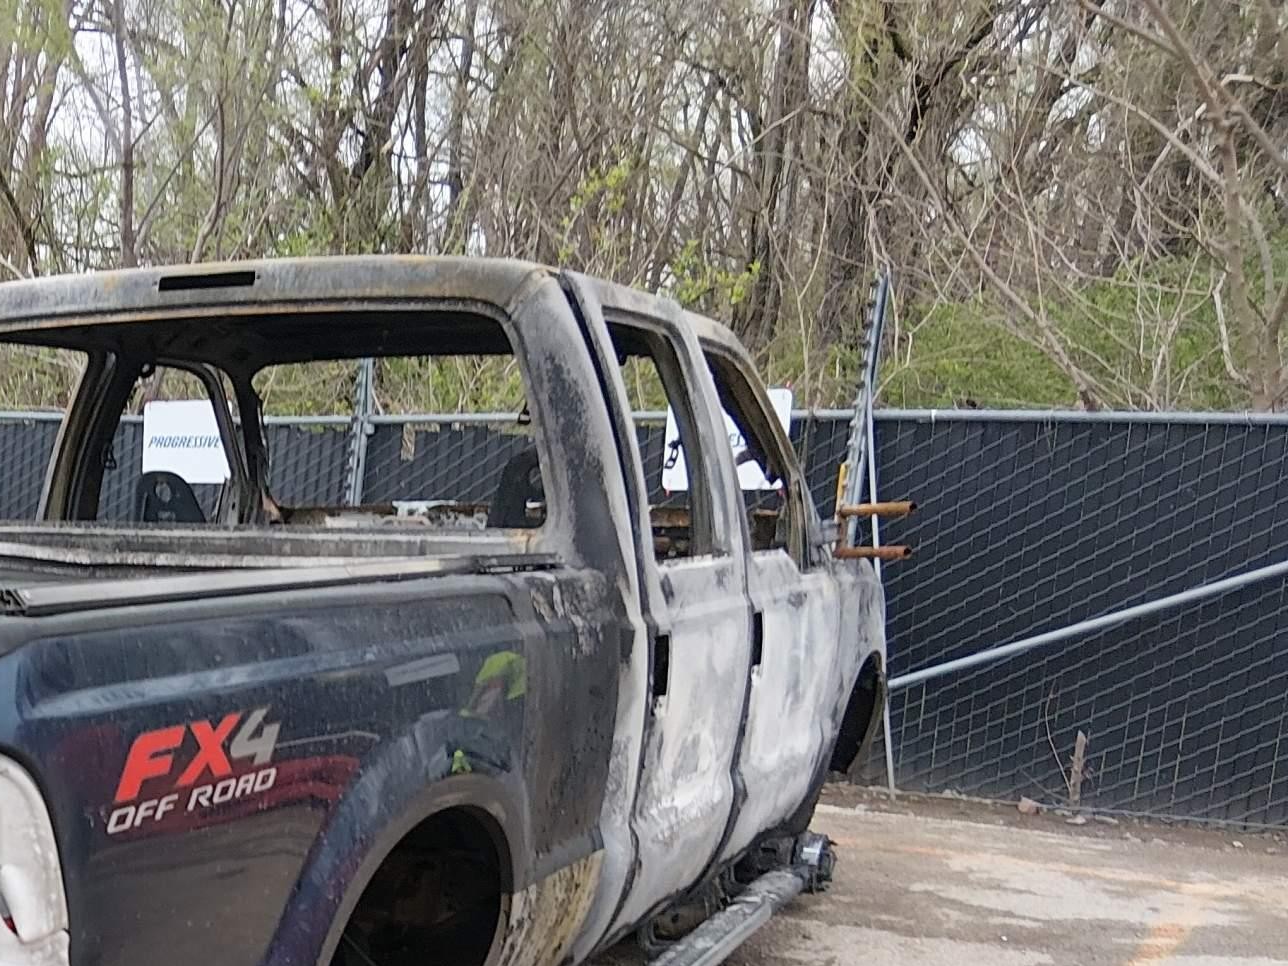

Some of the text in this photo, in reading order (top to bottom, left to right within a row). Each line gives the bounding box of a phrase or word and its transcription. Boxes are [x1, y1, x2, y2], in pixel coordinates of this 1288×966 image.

[148, 435, 221, 448] PROGRESSIVE
[115, 707, 280, 803] FX4
[107, 767, 277, 834] OFF ROAD
